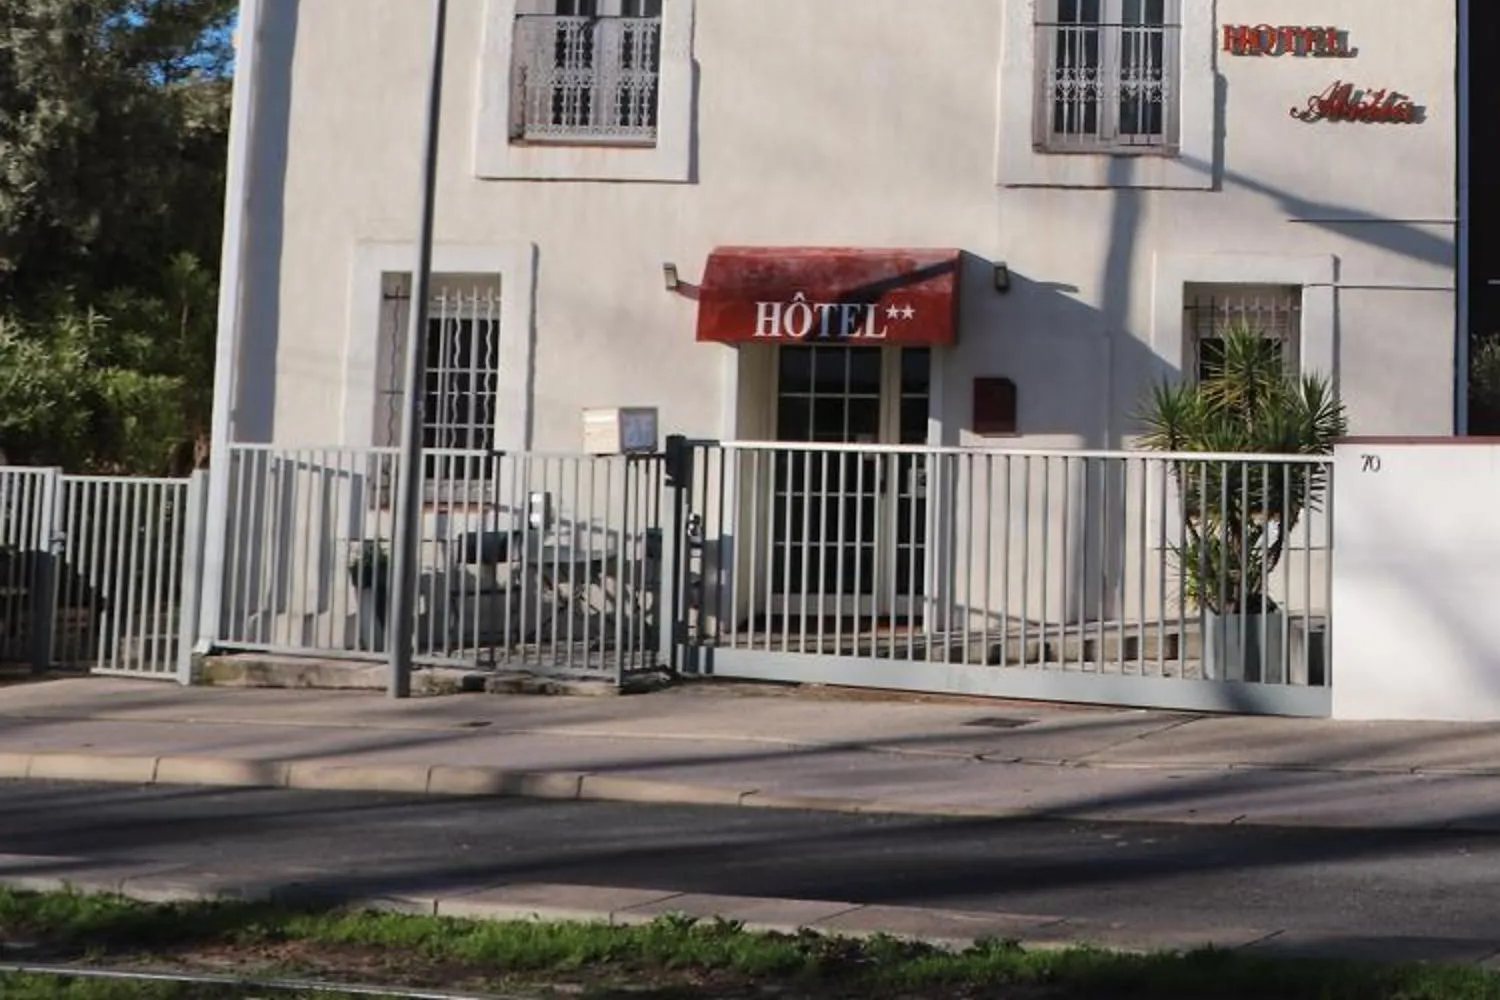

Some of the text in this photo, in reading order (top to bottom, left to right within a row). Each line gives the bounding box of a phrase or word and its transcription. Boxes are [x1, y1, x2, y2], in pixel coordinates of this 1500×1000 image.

[1222, 24, 1354, 56] HOTEL
[752, 291, 887, 338] HÔTEL
[1361, 454, 1381, 473] 70
